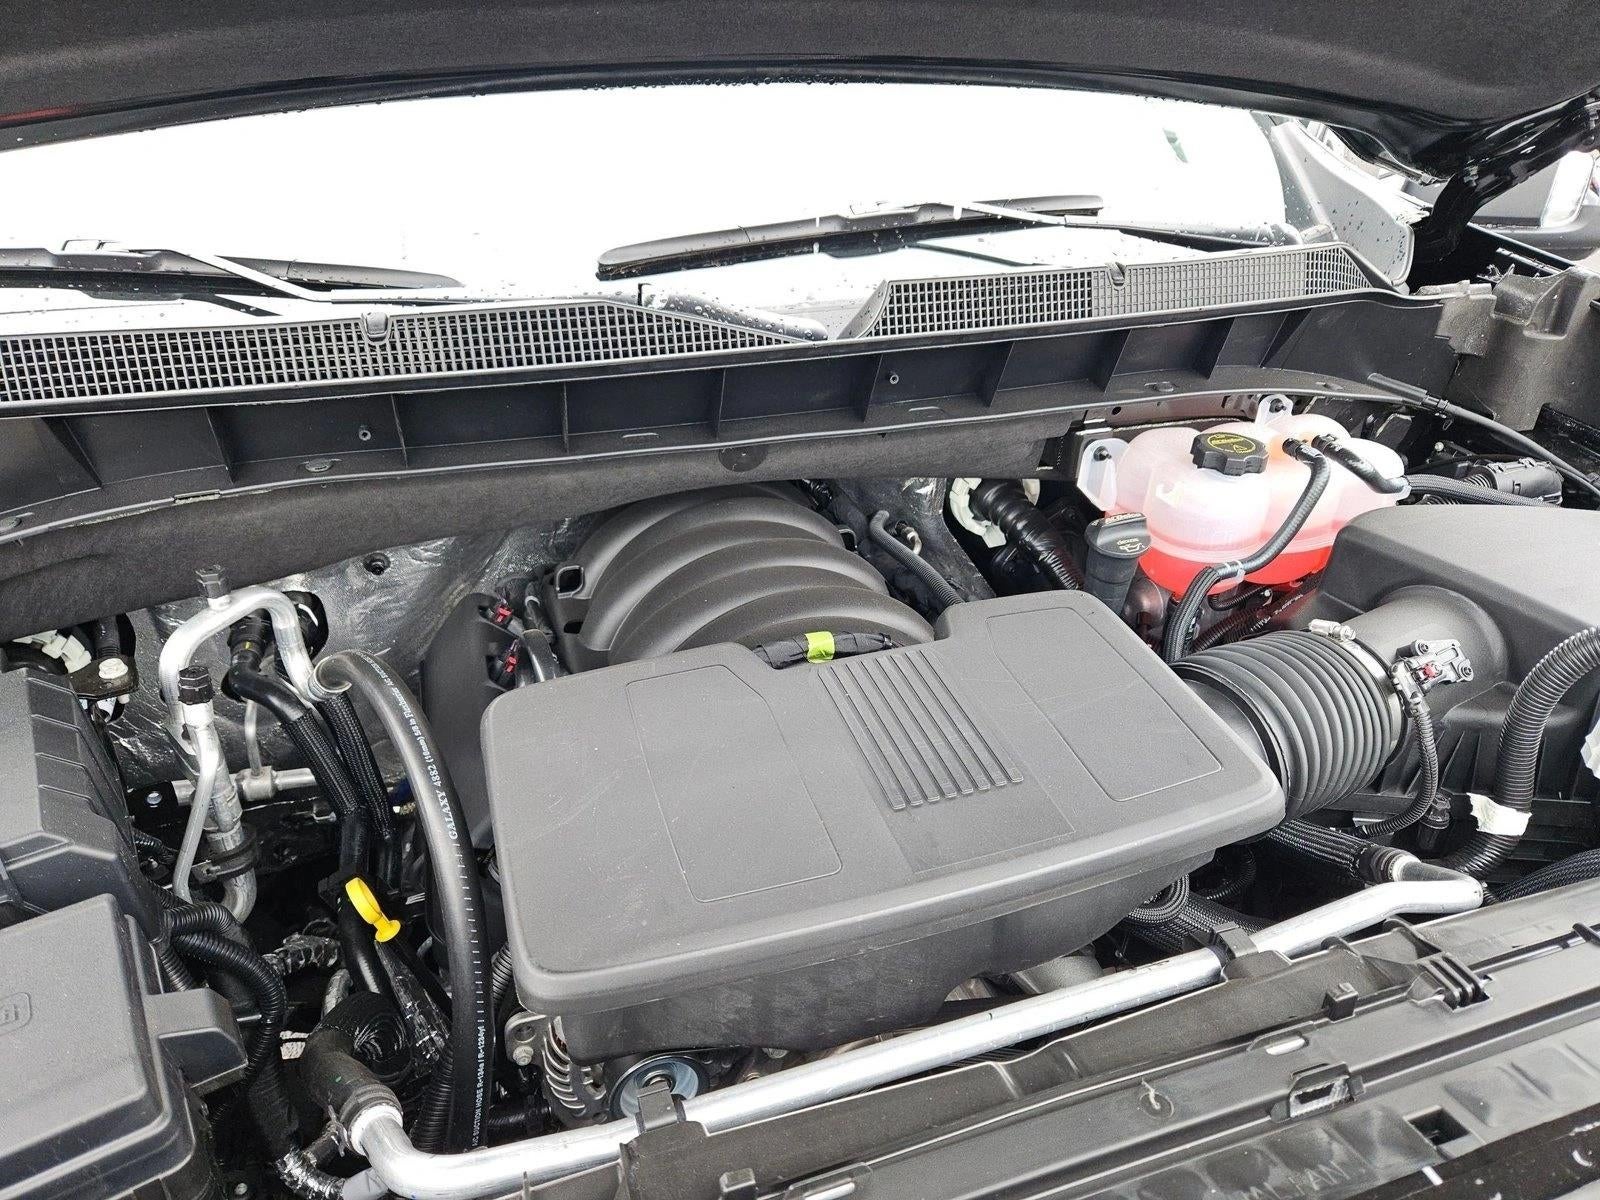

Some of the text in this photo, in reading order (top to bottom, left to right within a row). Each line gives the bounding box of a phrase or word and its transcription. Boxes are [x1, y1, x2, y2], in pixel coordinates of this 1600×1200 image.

[427, 763, 442, 787] 4882
[435, 789, 458, 840] GALAXY
[476, 1062, 485, 1088] R-134a
[475, 1088, 484, 1108] HOSE
[472, 1108, 482, 1137] SUCTION
